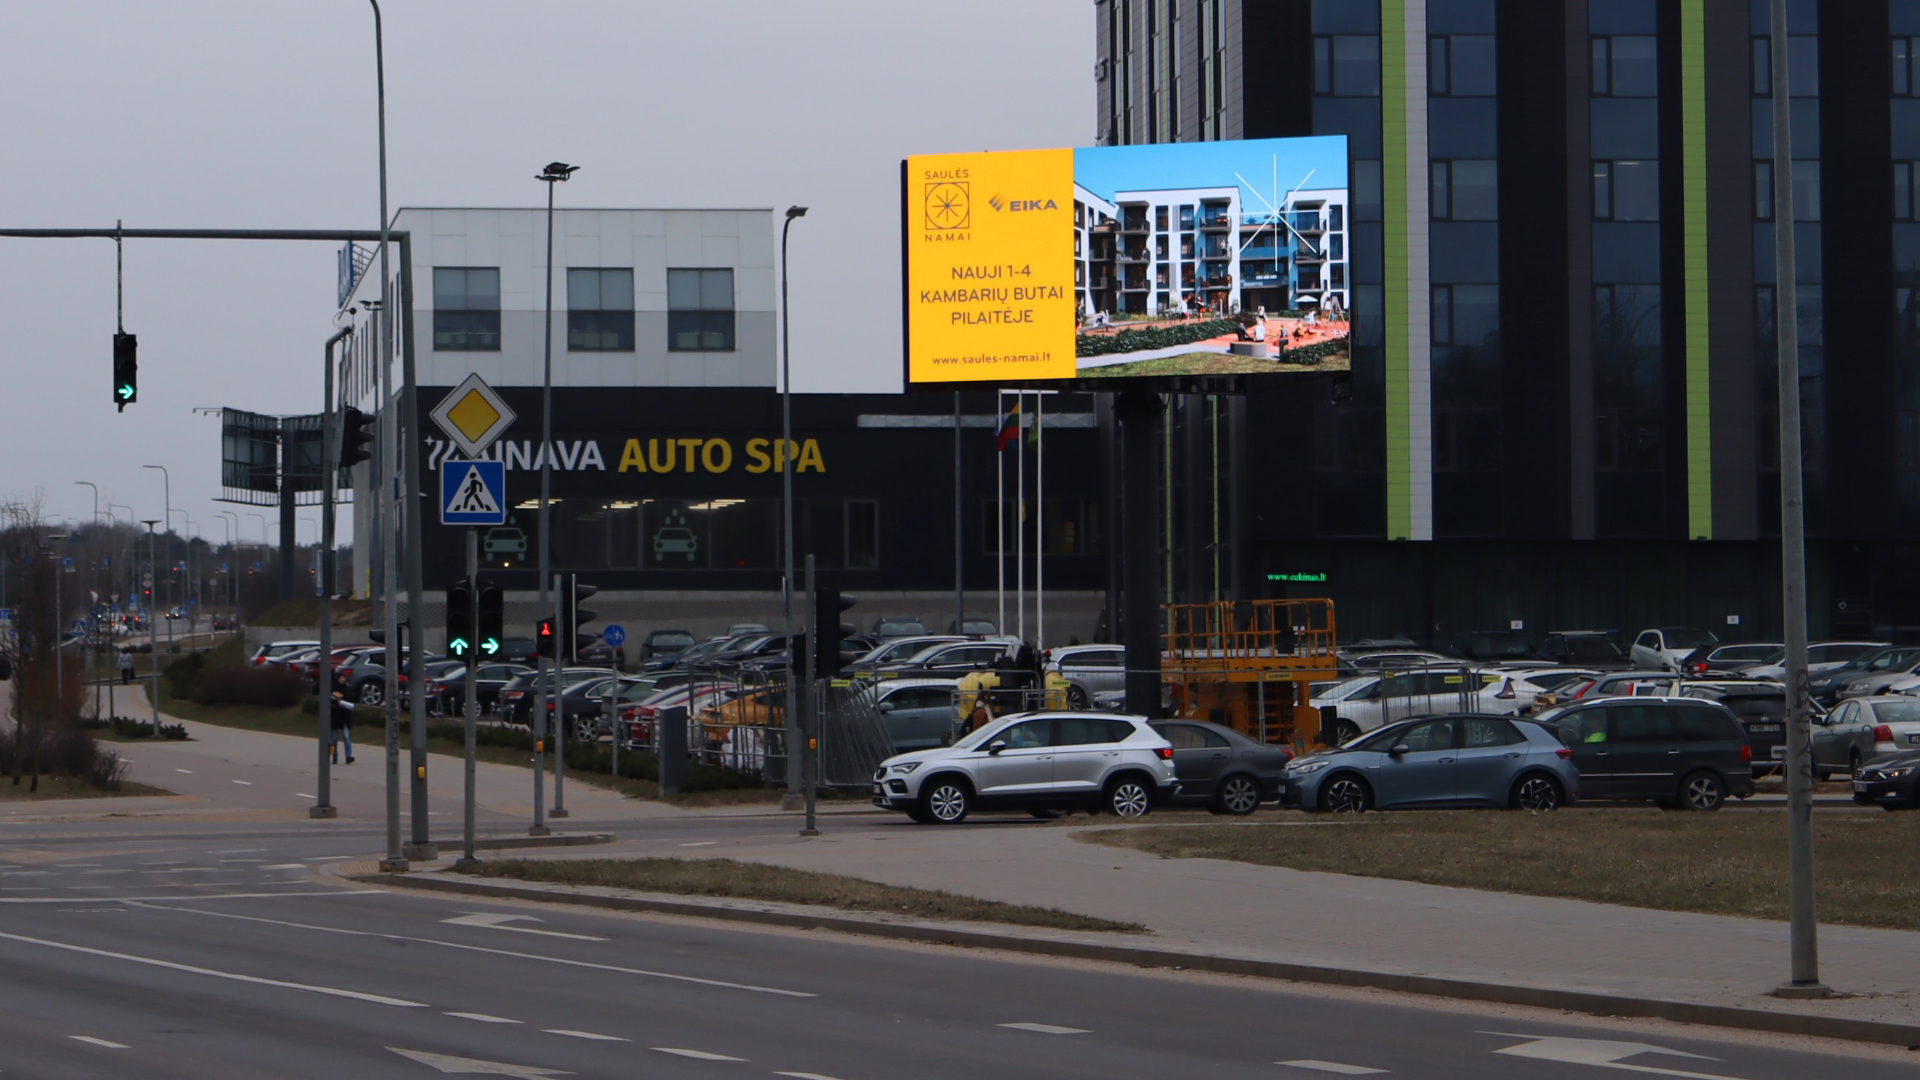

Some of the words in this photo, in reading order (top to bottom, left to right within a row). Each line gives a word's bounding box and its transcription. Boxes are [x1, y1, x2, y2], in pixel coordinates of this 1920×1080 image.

[924, 168, 970, 180] SAULĖS
[1009, 199, 1058, 212] EIKA
[924, 232, 971, 243] NAMAI
[951, 265, 1002, 280] NAUJI
[1007, 264, 1032, 279] 1-4
[920, 286, 1009, 304] KAMBARIŲ
[1013, 285, 1064, 301] BUTAI
[951, 307, 1034, 325] PILAITĖJE
[932, 352, 1051, 365] www.saules-namai.lt
[618, 438, 733, 474] AUTO
[744, 438, 827, 474] SPA
